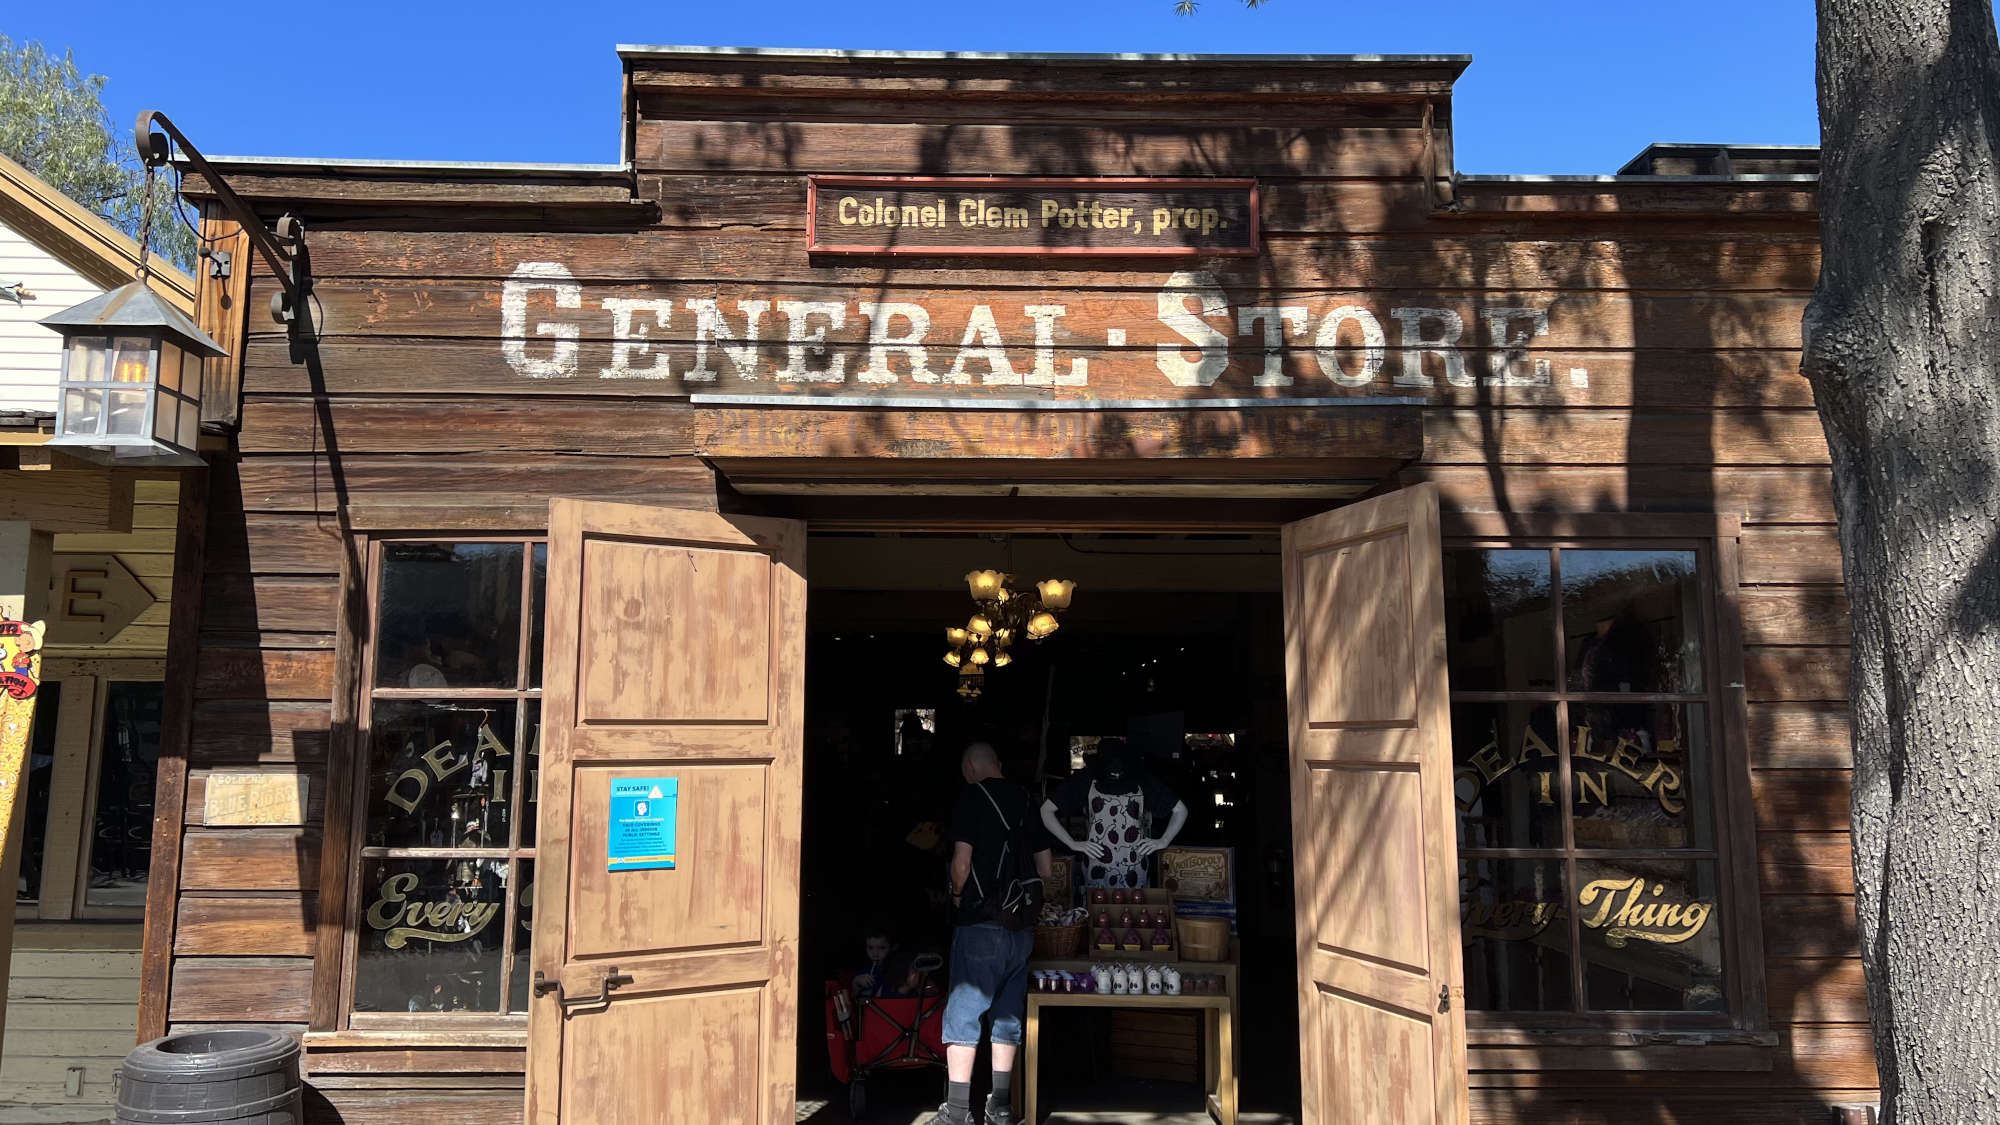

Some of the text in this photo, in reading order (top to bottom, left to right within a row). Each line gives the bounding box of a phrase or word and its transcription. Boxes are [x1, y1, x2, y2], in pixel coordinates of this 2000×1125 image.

[838, 196, 1228, 236] Colonel Clem Potter, prop.
[501, 262, 1088, 387] GENERAL
[1538, 771, 1609, 806] IN
[367, 872, 500, 950] Every
[1579, 877, 1711, 949] Thing
